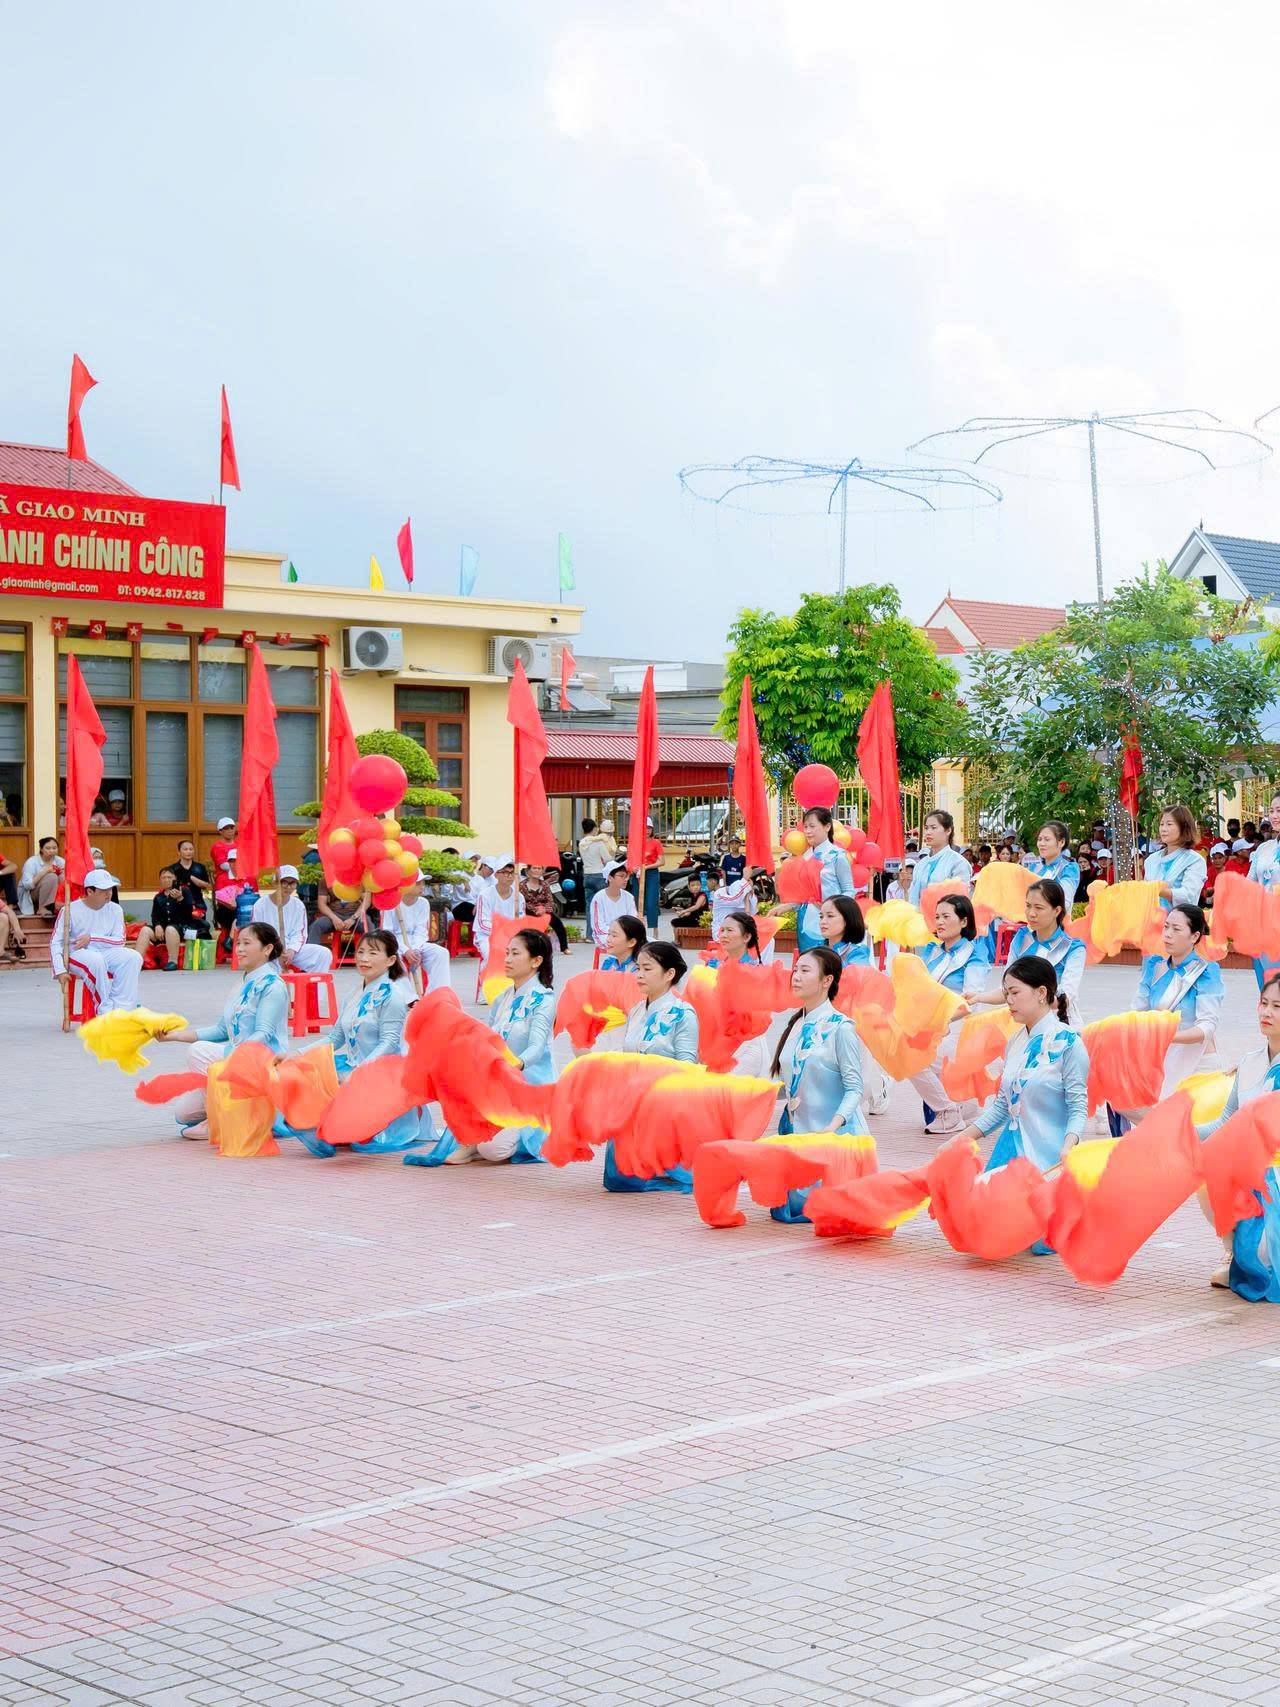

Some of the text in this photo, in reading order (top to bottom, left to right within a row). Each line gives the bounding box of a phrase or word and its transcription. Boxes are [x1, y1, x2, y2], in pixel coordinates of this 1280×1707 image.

[16, 500, 75, 520] GIAO
[82, 507, 146, 527] MINH
[54, 530, 131, 571] CHÍNH
[139, 536, 204, 578] CÔNG
